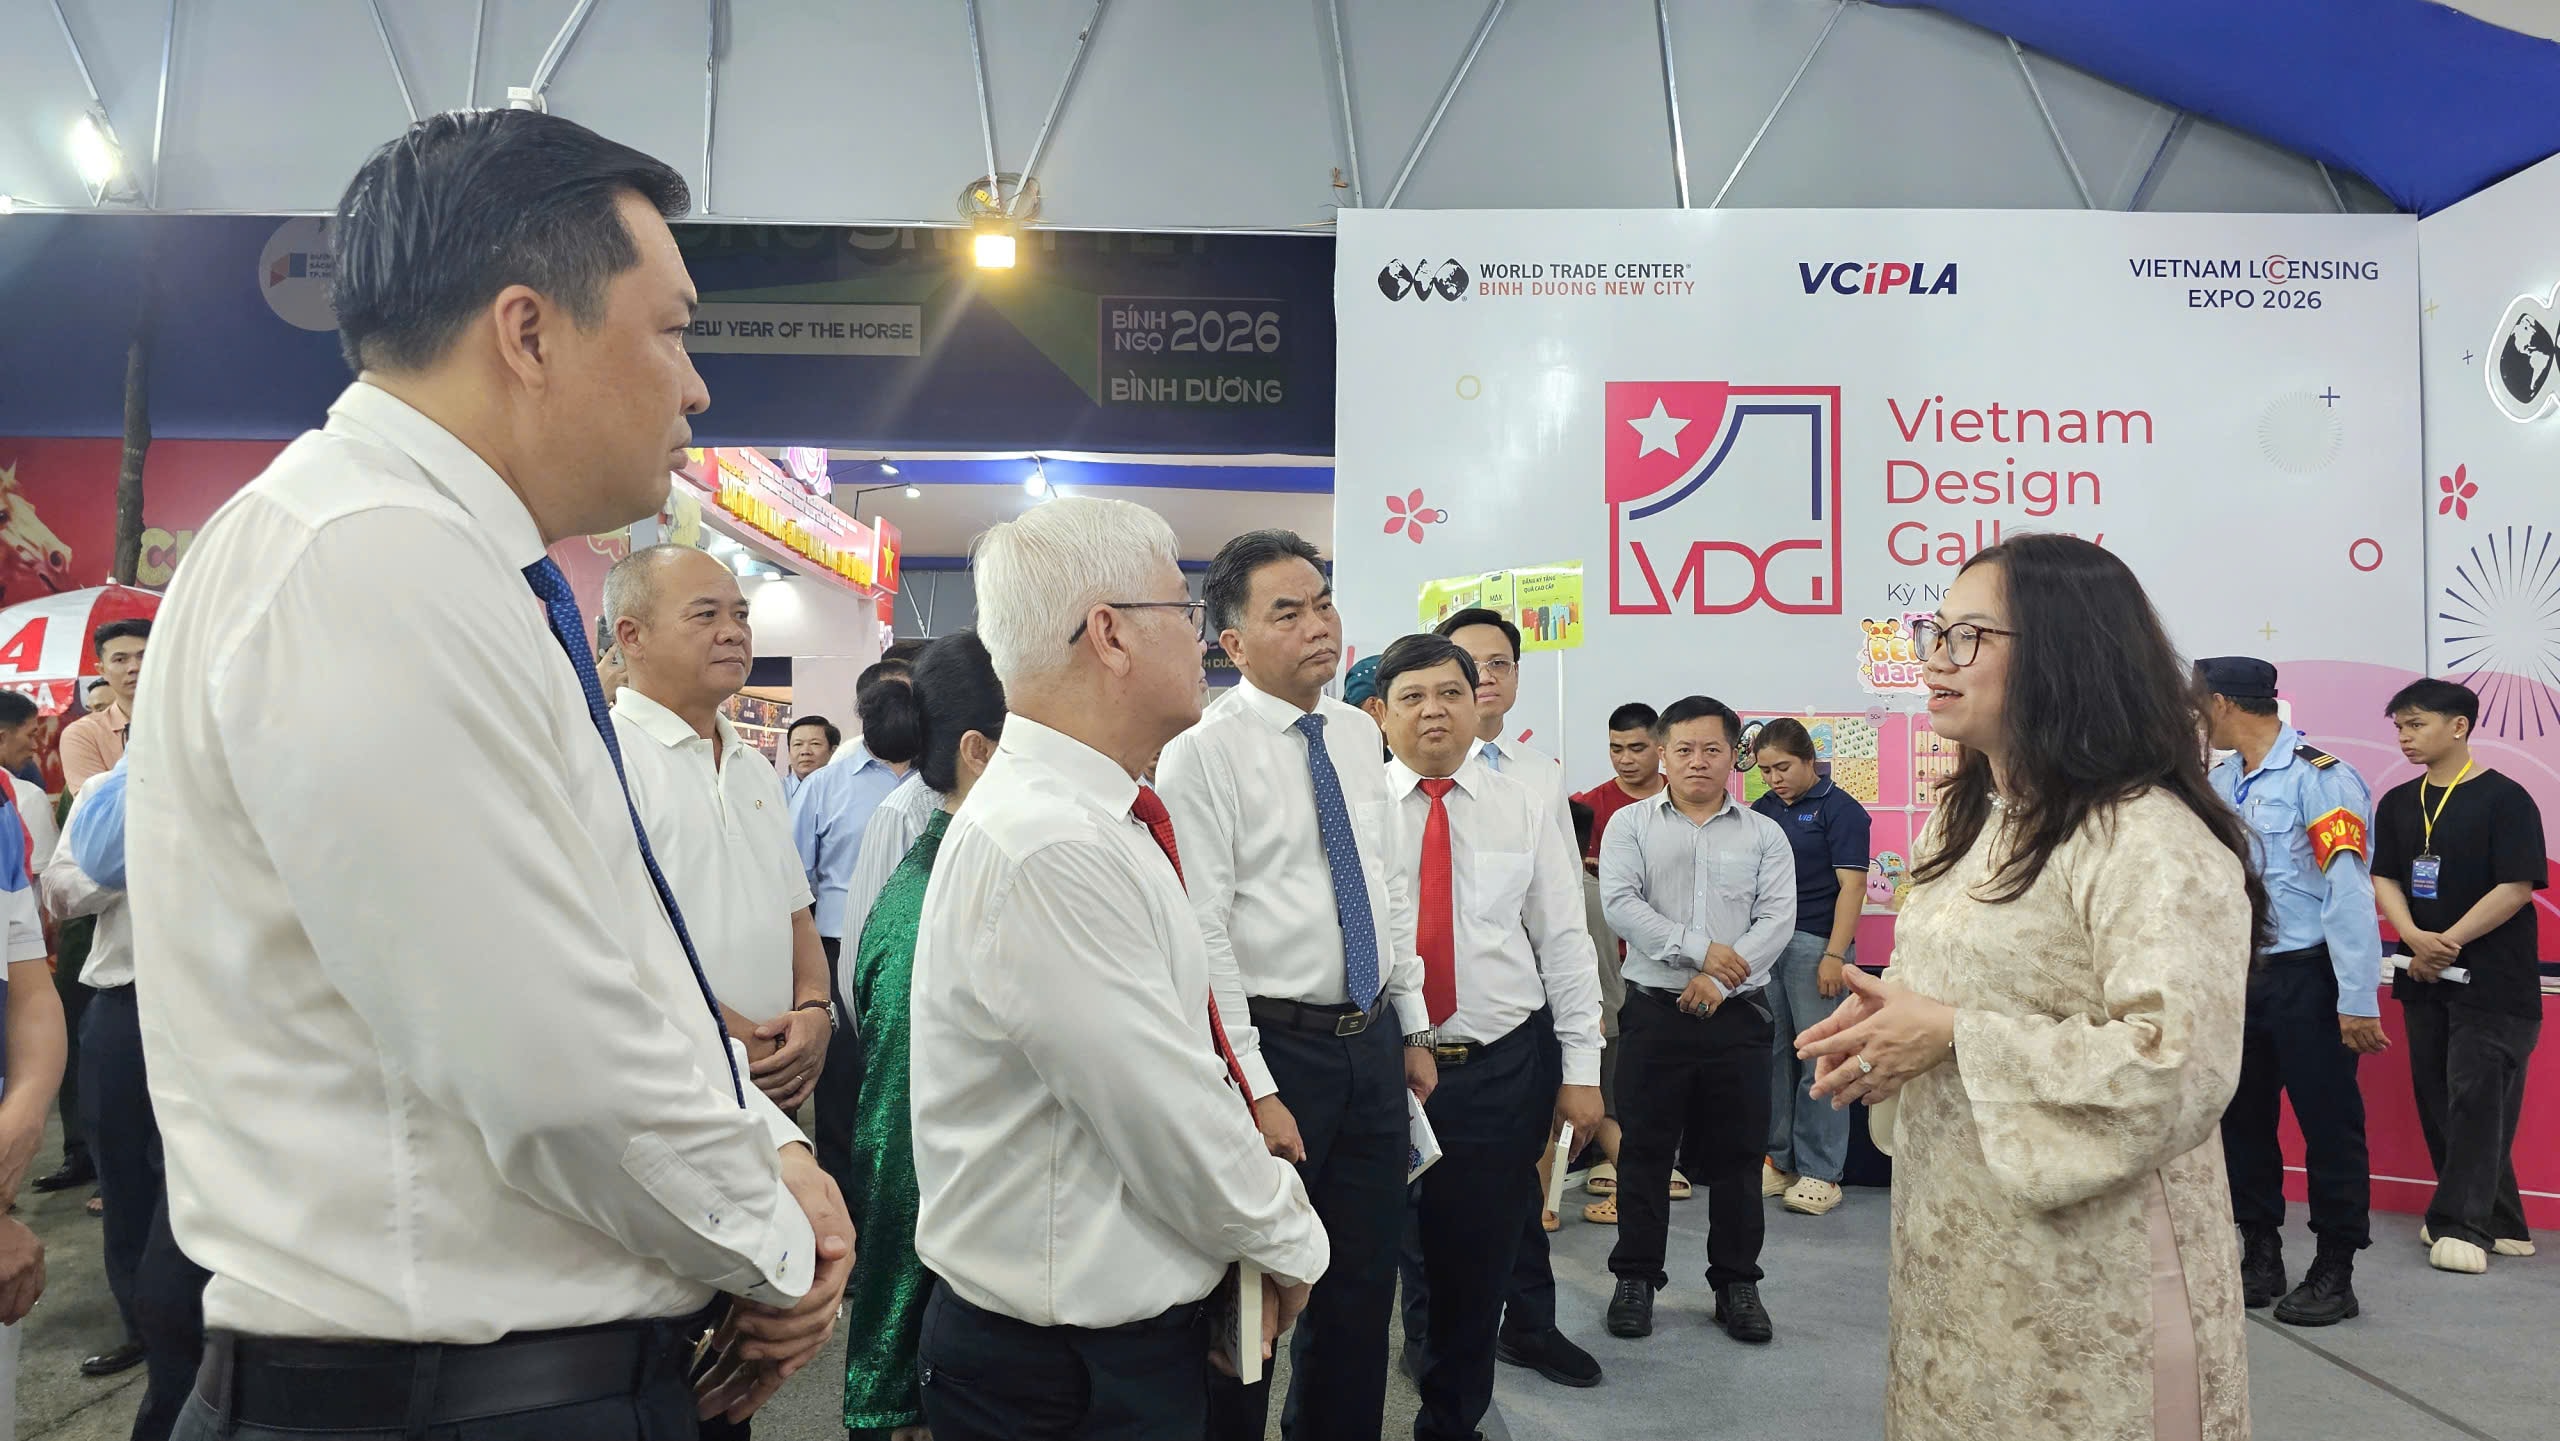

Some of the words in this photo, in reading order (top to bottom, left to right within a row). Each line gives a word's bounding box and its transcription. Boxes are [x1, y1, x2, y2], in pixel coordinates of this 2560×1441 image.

[1481, 263, 1544, 279] WORLD
[1549, 263, 1608, 279] TRADE
[2129, 258, 2241, 279] VIETNAM
[1480, 281, 1524, 296] BINH
[1531, 281, 1597, 296] DUONG
[1604, 281, 1646, 296] NEW
[1653, 281, 1695, 295] CITY
[2188, 289, 2255, 309] EXPO
[2262, 290, 2322, 309] 2026
[1112, 303, 1166, 330] BÍNH
[727, 320, 774, 338] YEAR
[778, 321, 803, 339] OF
[808, 322, 845, 339] THE
[849, 322, 913, 340] HORSE
[1170, 309, 1281, 353] 2026
[1115, 331, 1164, 355] NGỌ
[1111, 369, 1178, 402] BÌNH
[1185, 375, 1283, 403] DƯƠNG
[1887, 395, 2153, 444] Vietnam
[1887, 457, 2101, 517] Design
[1887, 583, 1916, 606] Kỳ
